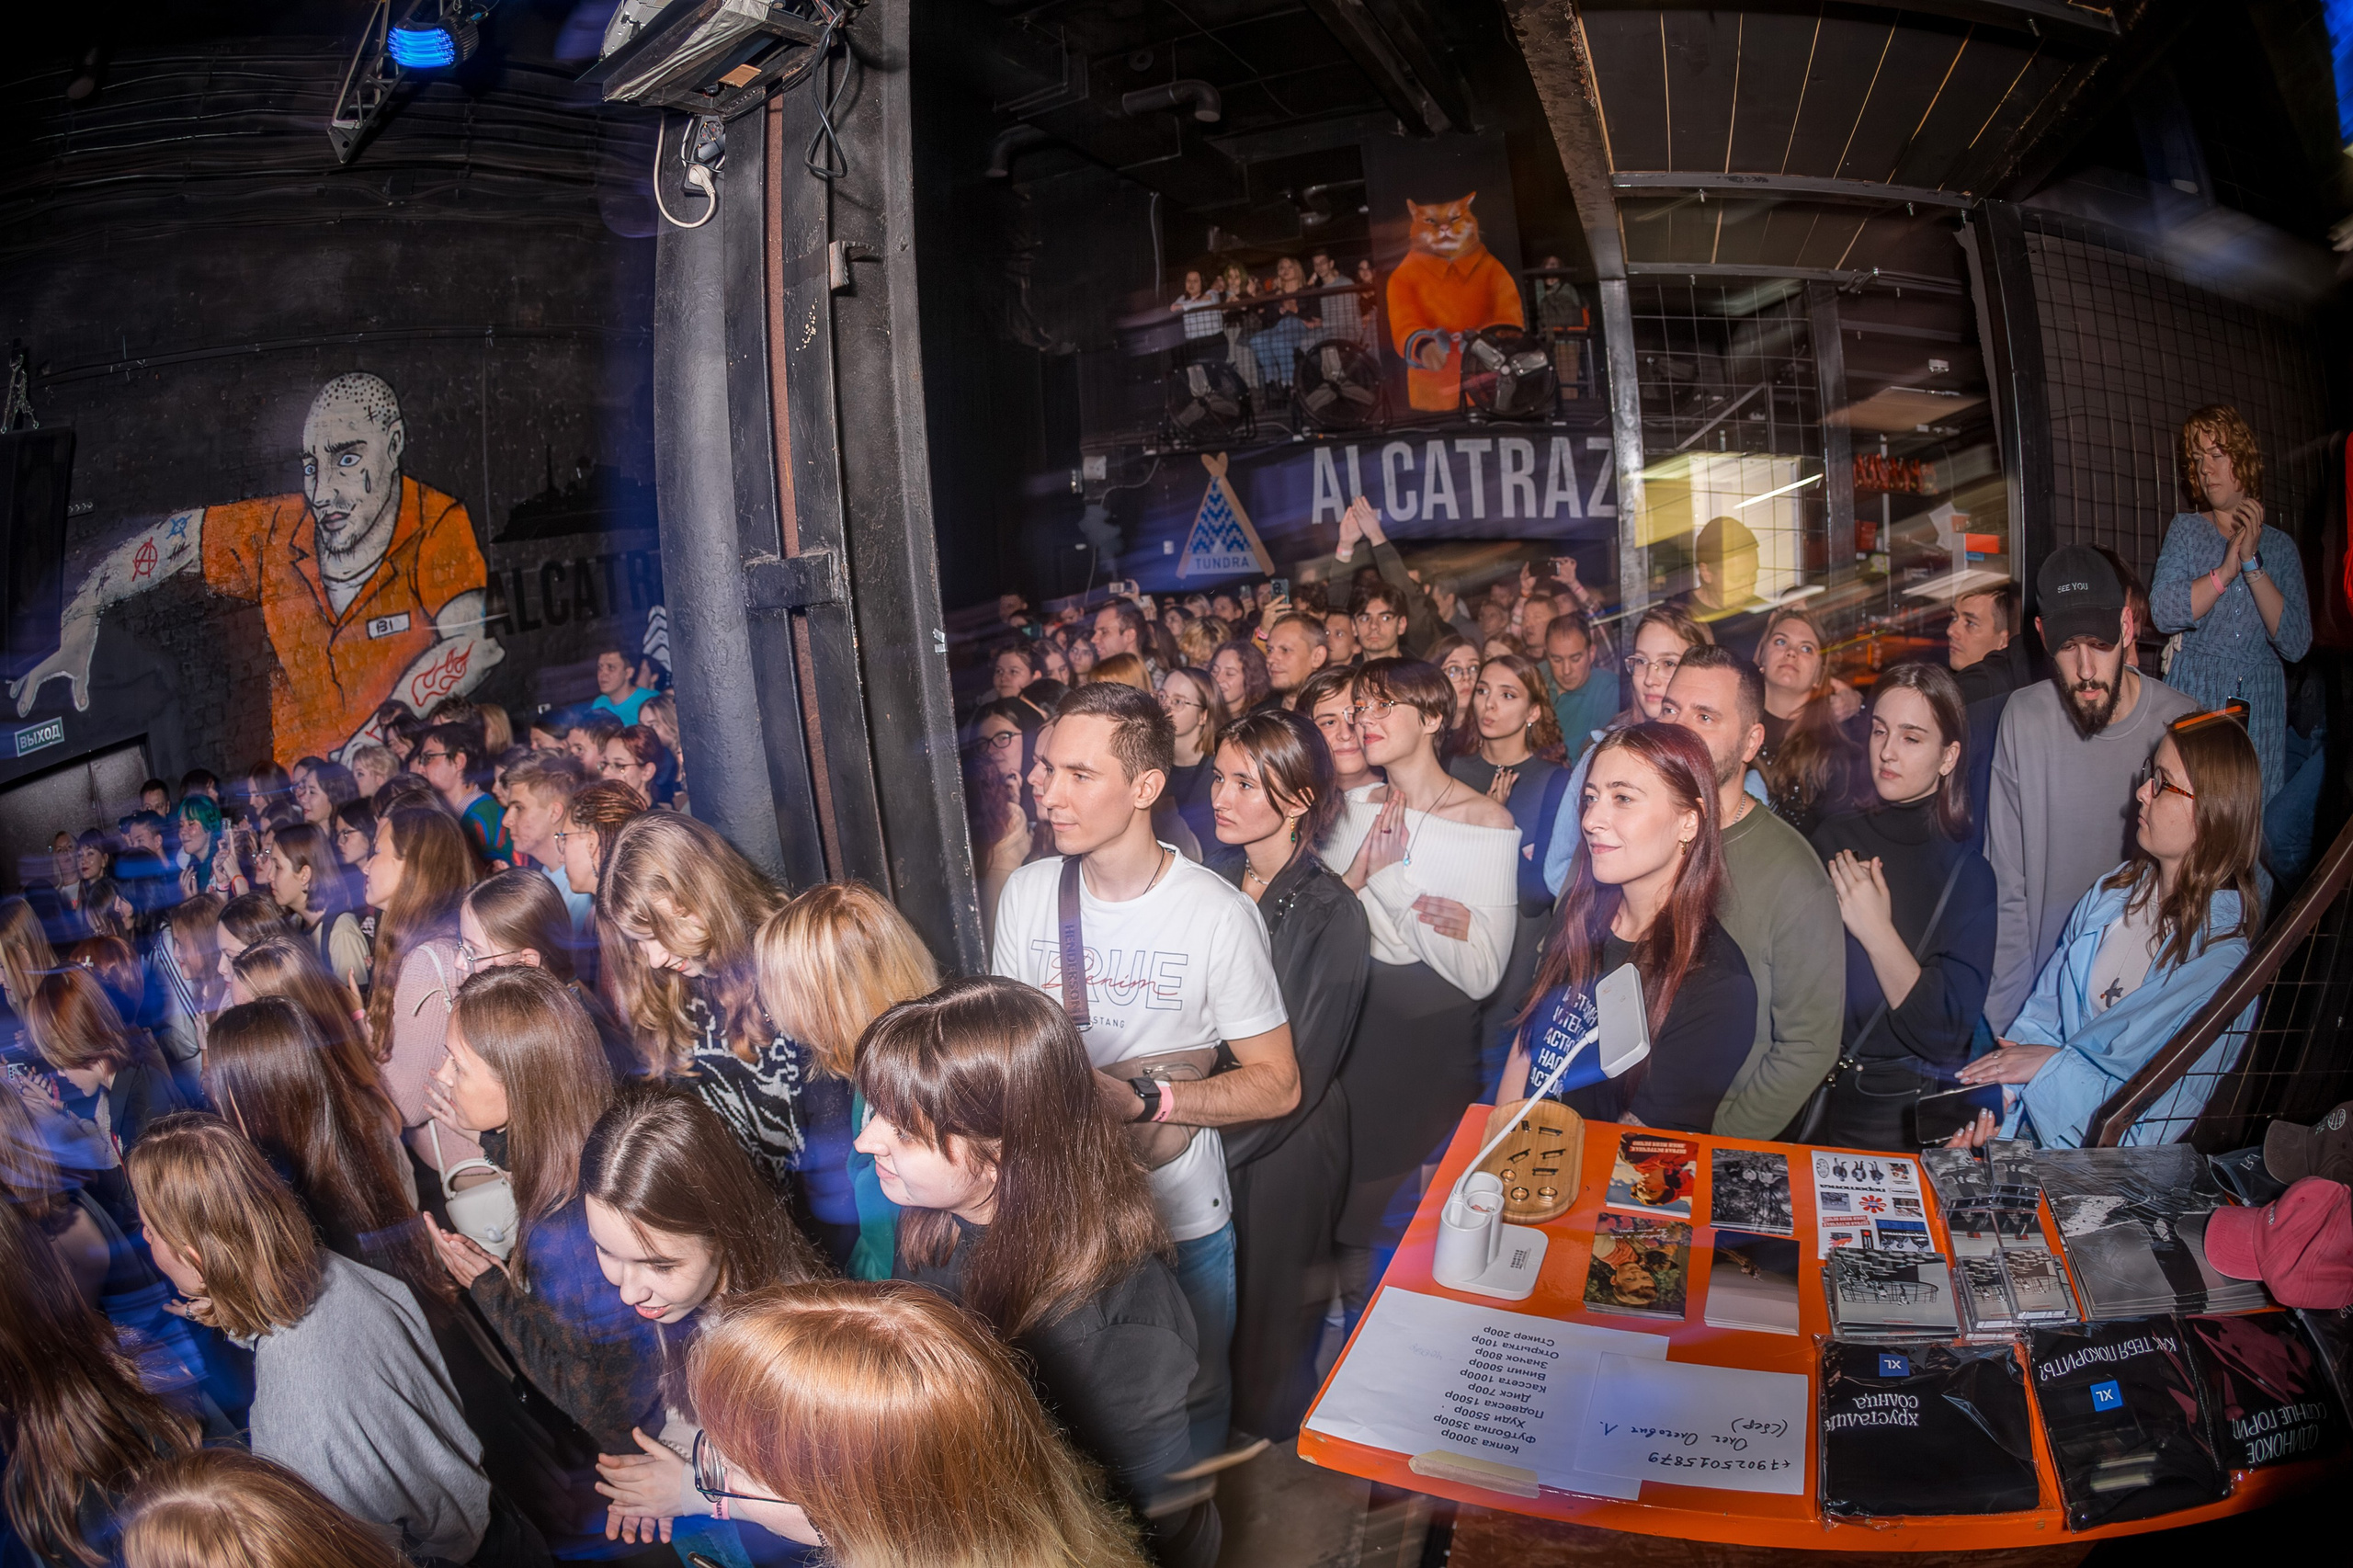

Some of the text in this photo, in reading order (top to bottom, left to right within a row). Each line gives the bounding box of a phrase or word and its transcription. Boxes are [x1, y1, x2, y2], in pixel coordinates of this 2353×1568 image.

[1311, 436, 1618, 525] ALCATRAZ
[1195, 555, 1251, 570] TUNDRA
[2057, 582, 2089, 594] SEE YOU
[19, 724, 61, 749] ВЫХОД
[1064, 924, 1082, 1013] HENDERSON
[1091, 1016, 1125, 1028] STANG
[1471, 1335, 1560, 1359] Открытка 100р
[1483, 1326, 1555, 1347] Стикер 200р
[1468, 1358, 1546, 1381] Винил 5000р
[1474, 1347, 1549, 1369] Значок 800р
[1883, 1359, 1902, 1369] XL
[2038, 1336, 2177, 1381] КАК ТЕБЯ ПОКОРИТЬ?
[1460, 1369, 1547, 1393] Кассета 1000р
[1467, 1383, 1532, 1403] Диск 700р
[1852, 1392, 1919, 1409] солнца
[2096, 1388, 2114, 1402] XL
[1444, 1391, 1544, 1419] Подвеска 1500р
[1453, 1405, 1527, 1429] Худи 5500р
[1433, 1414, 1537, 1444] Футболка 3500р
[1440, 1428, 1519, 1455] Кепка 3000р
[1711, 1434, 1748, 1451] Олег
[2245, 1424, 2319, 1463] ОДИНОКОЕ
[1647, 1451, 1791, 1471] +79025015879
